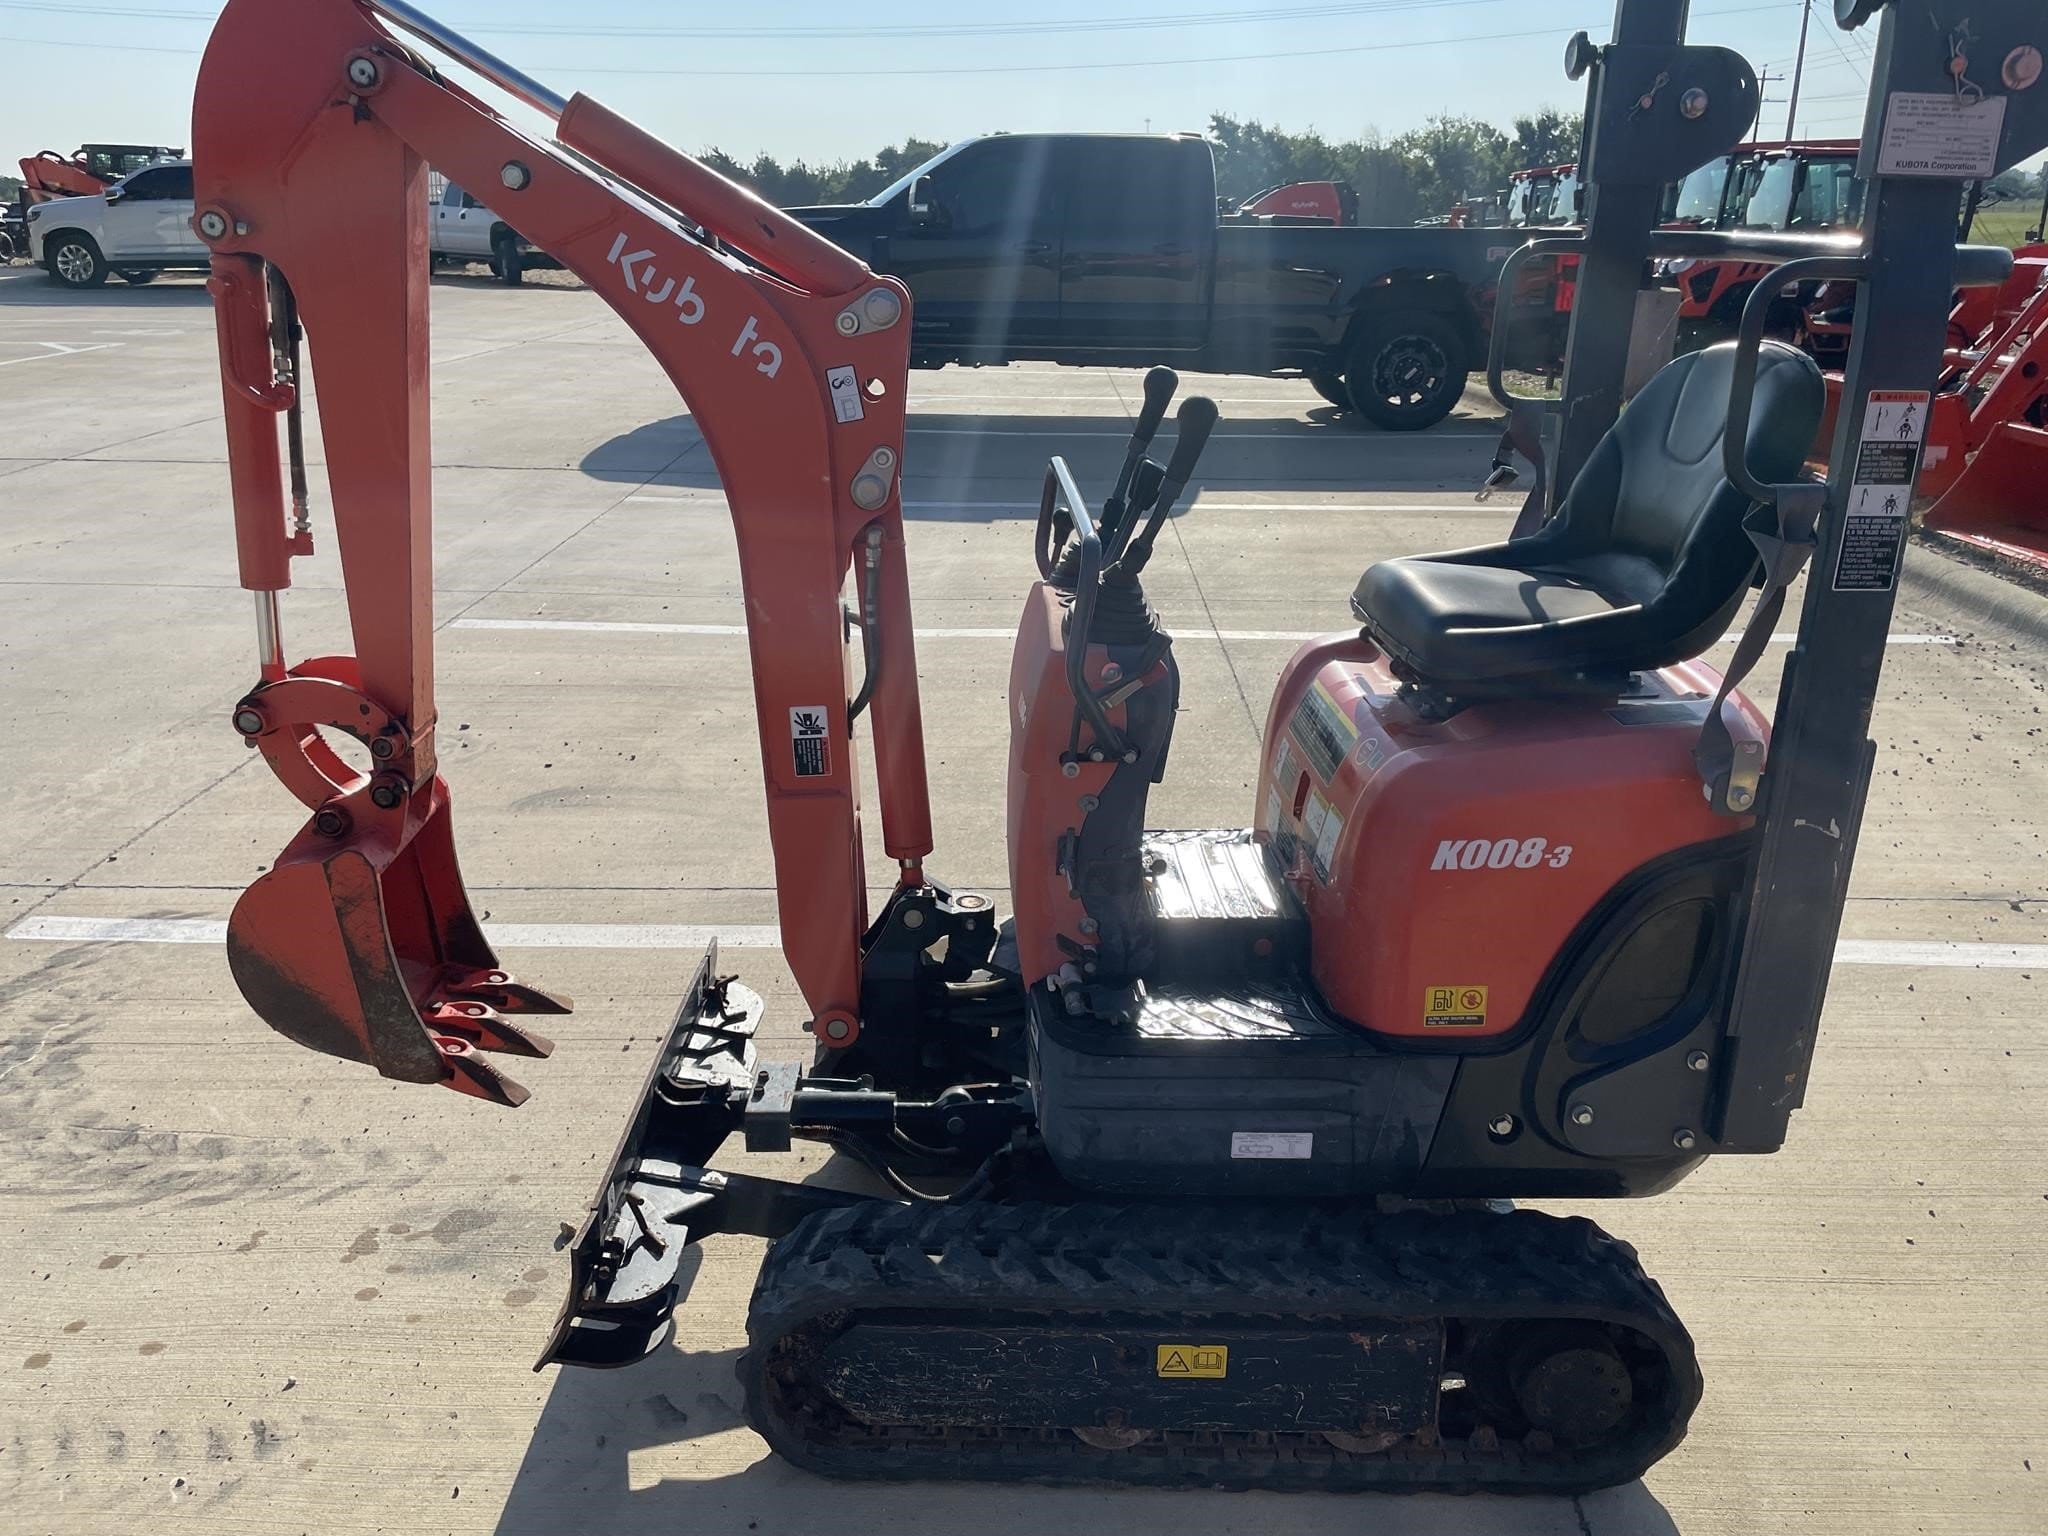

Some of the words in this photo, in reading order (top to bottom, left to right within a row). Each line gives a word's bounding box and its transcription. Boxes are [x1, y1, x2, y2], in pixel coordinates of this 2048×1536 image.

[1896, 160, 1929, 169] KUBOTA
[1931, 161, 1977, 171] Corporation
[1430, 837, 1573, 871] K008-3
